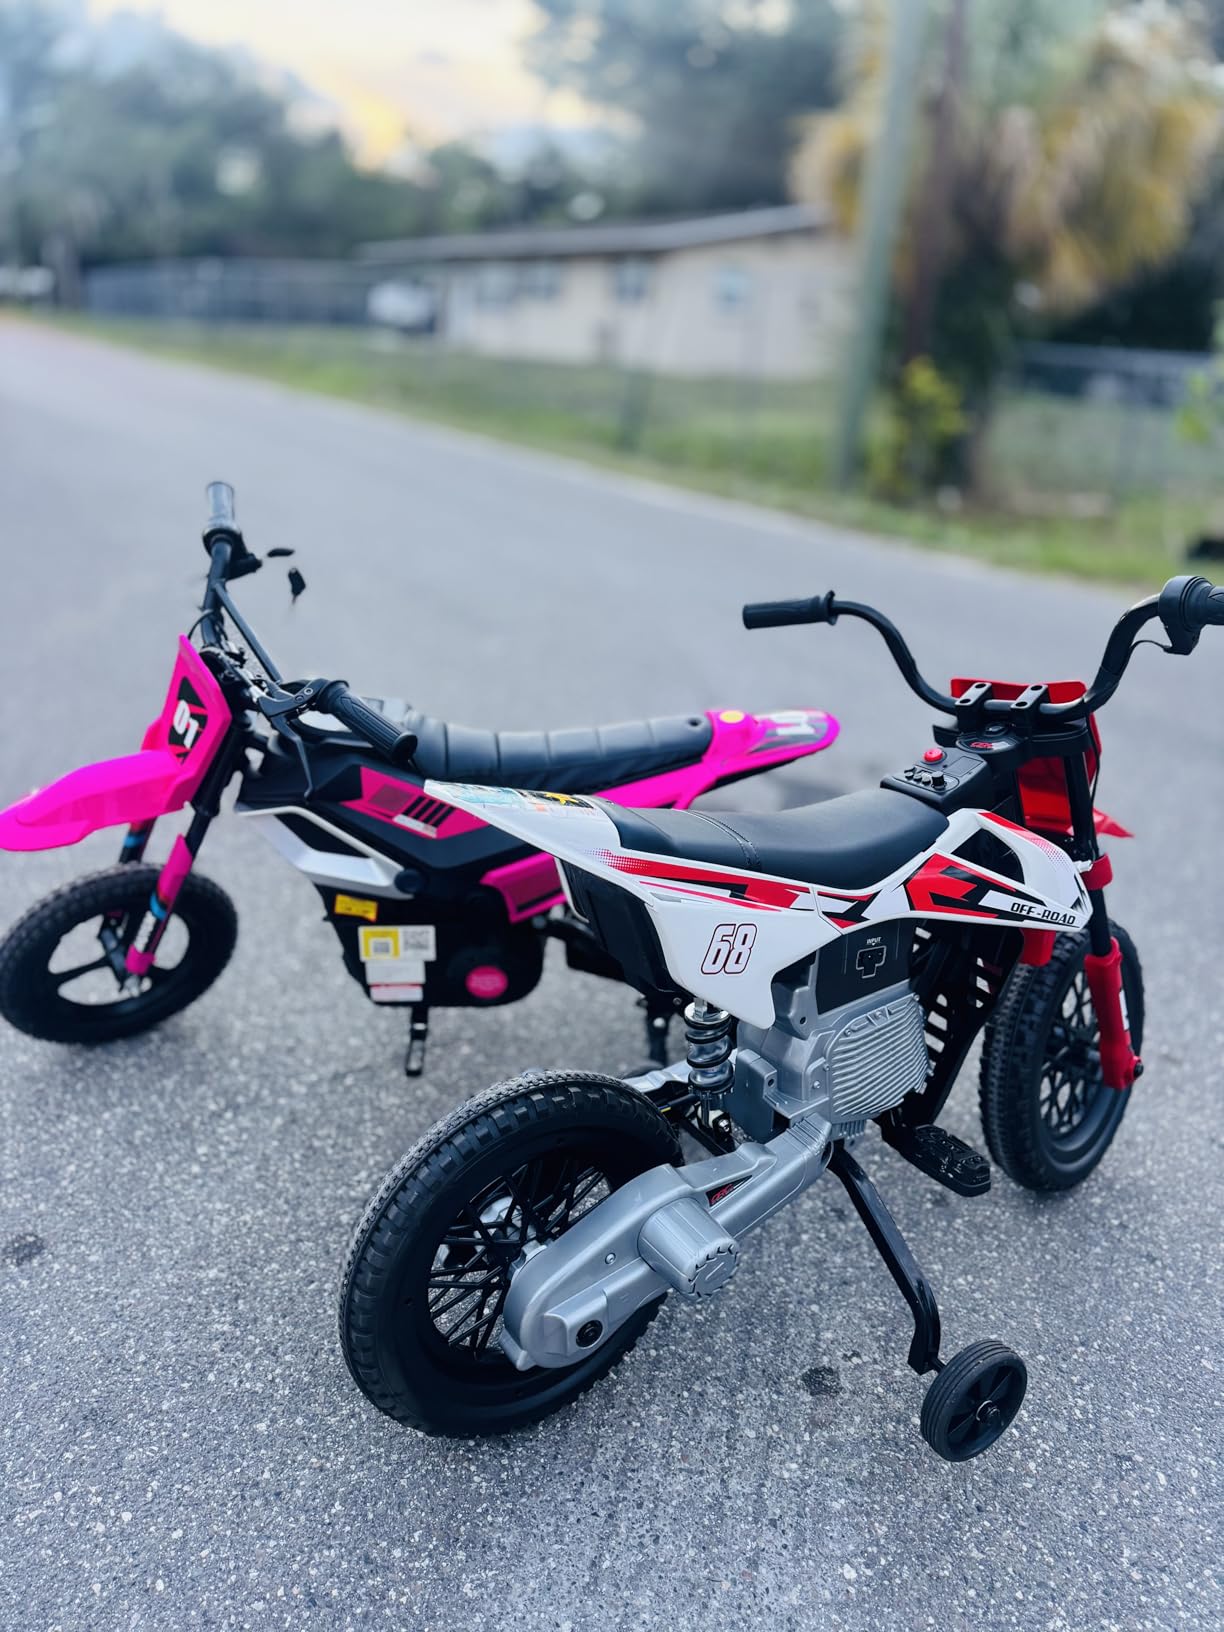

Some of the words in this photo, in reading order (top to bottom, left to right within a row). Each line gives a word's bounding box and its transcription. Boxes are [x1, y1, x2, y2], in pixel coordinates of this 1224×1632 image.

[1010, 902, 1076, 925] OFF-ROAD
[701, 923, 757, 975] 68
[866, 936, 882, 944] INPUT
